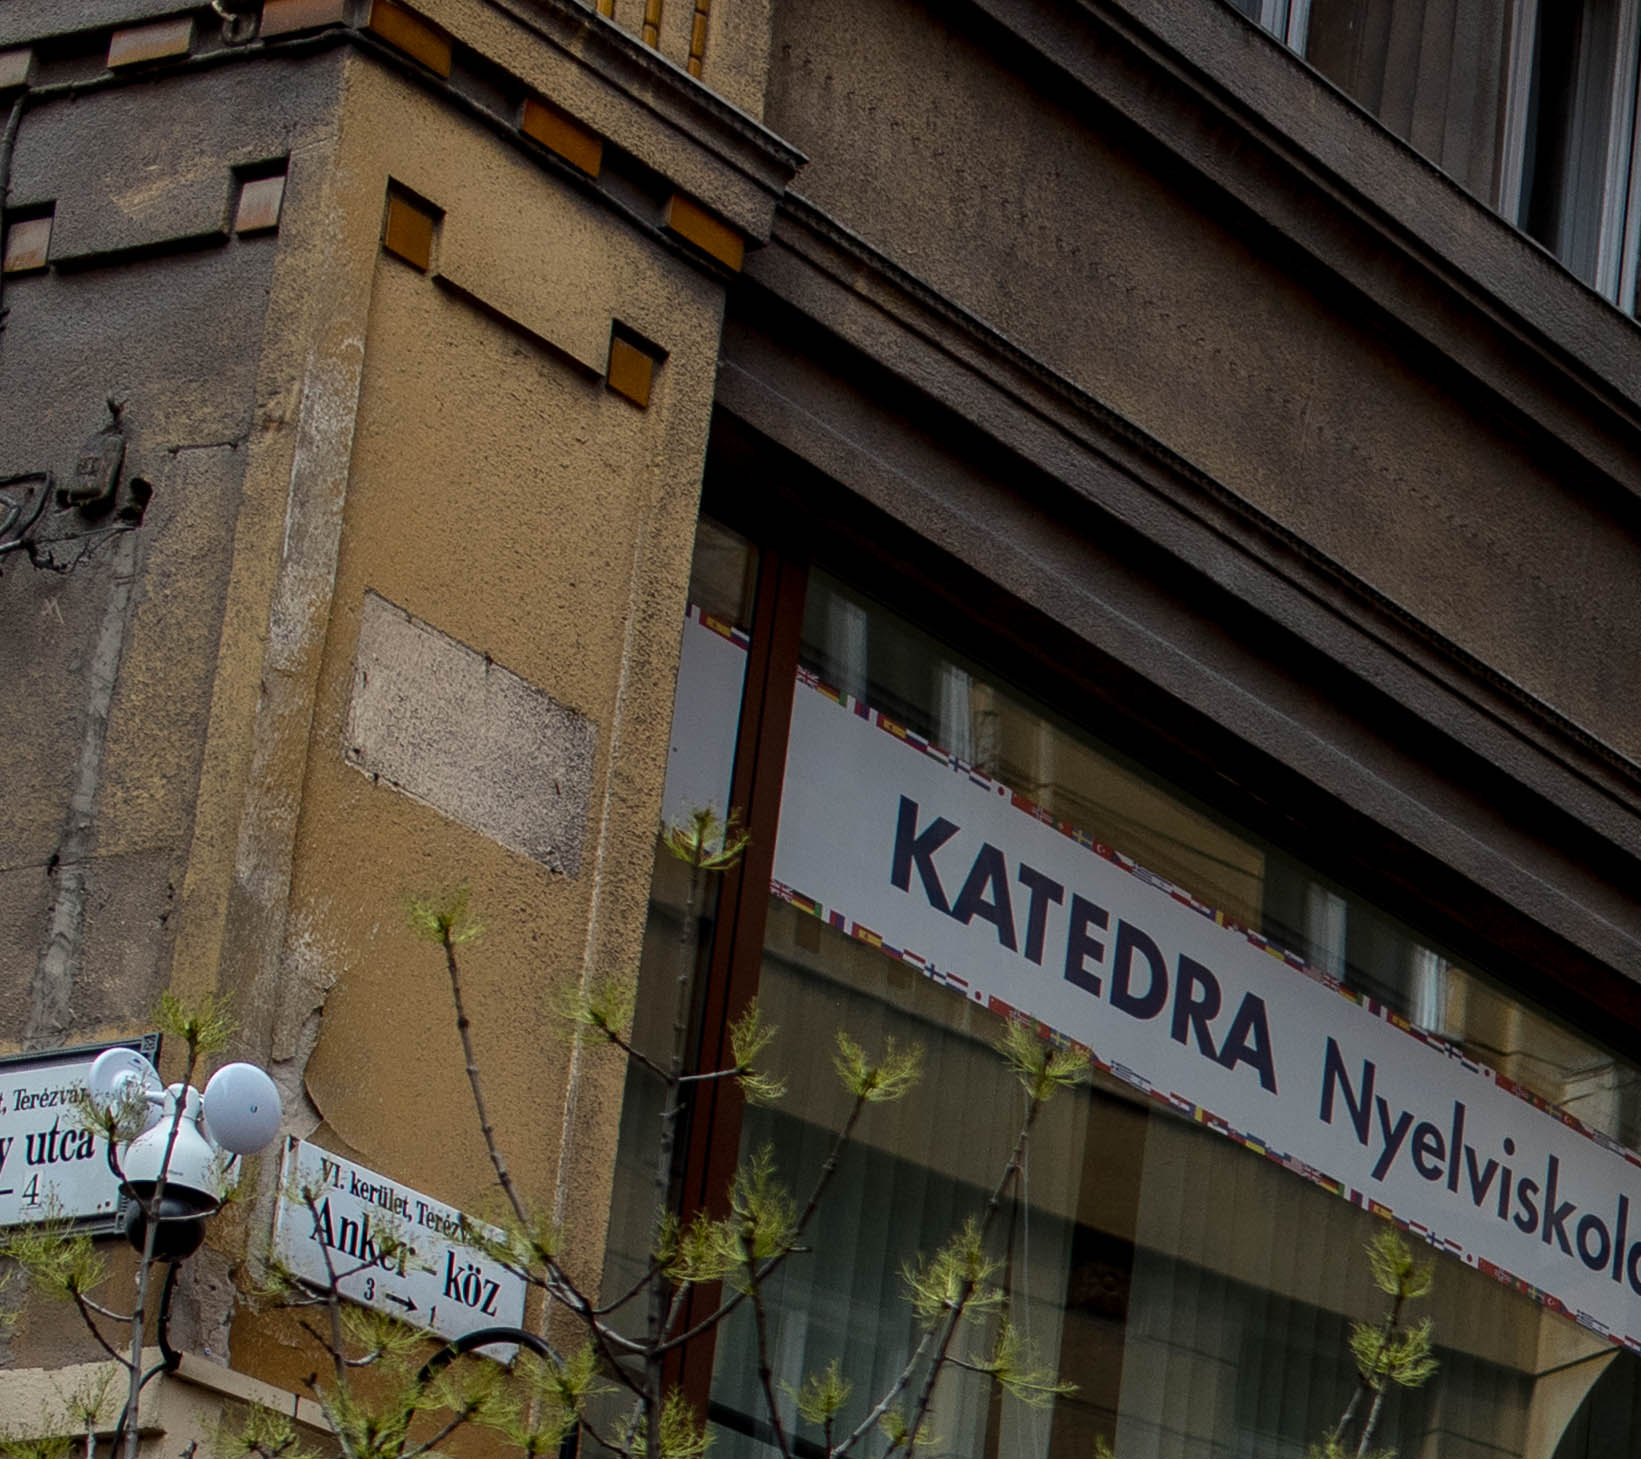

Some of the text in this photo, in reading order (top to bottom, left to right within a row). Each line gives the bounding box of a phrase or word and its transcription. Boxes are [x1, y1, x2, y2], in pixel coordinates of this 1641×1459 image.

[889, 794, 1278, 1095] KATEDRA
[26, 1114, 95, 1166] utca
[22, 1174, 40, 1206] 4
[321, 1157, 344, 1189] VI.
[350, 1172, 412, 1223] kerület,
[363, 1278, 437, 1328] 3 1
[443, 1250, 502, 1317] köz
